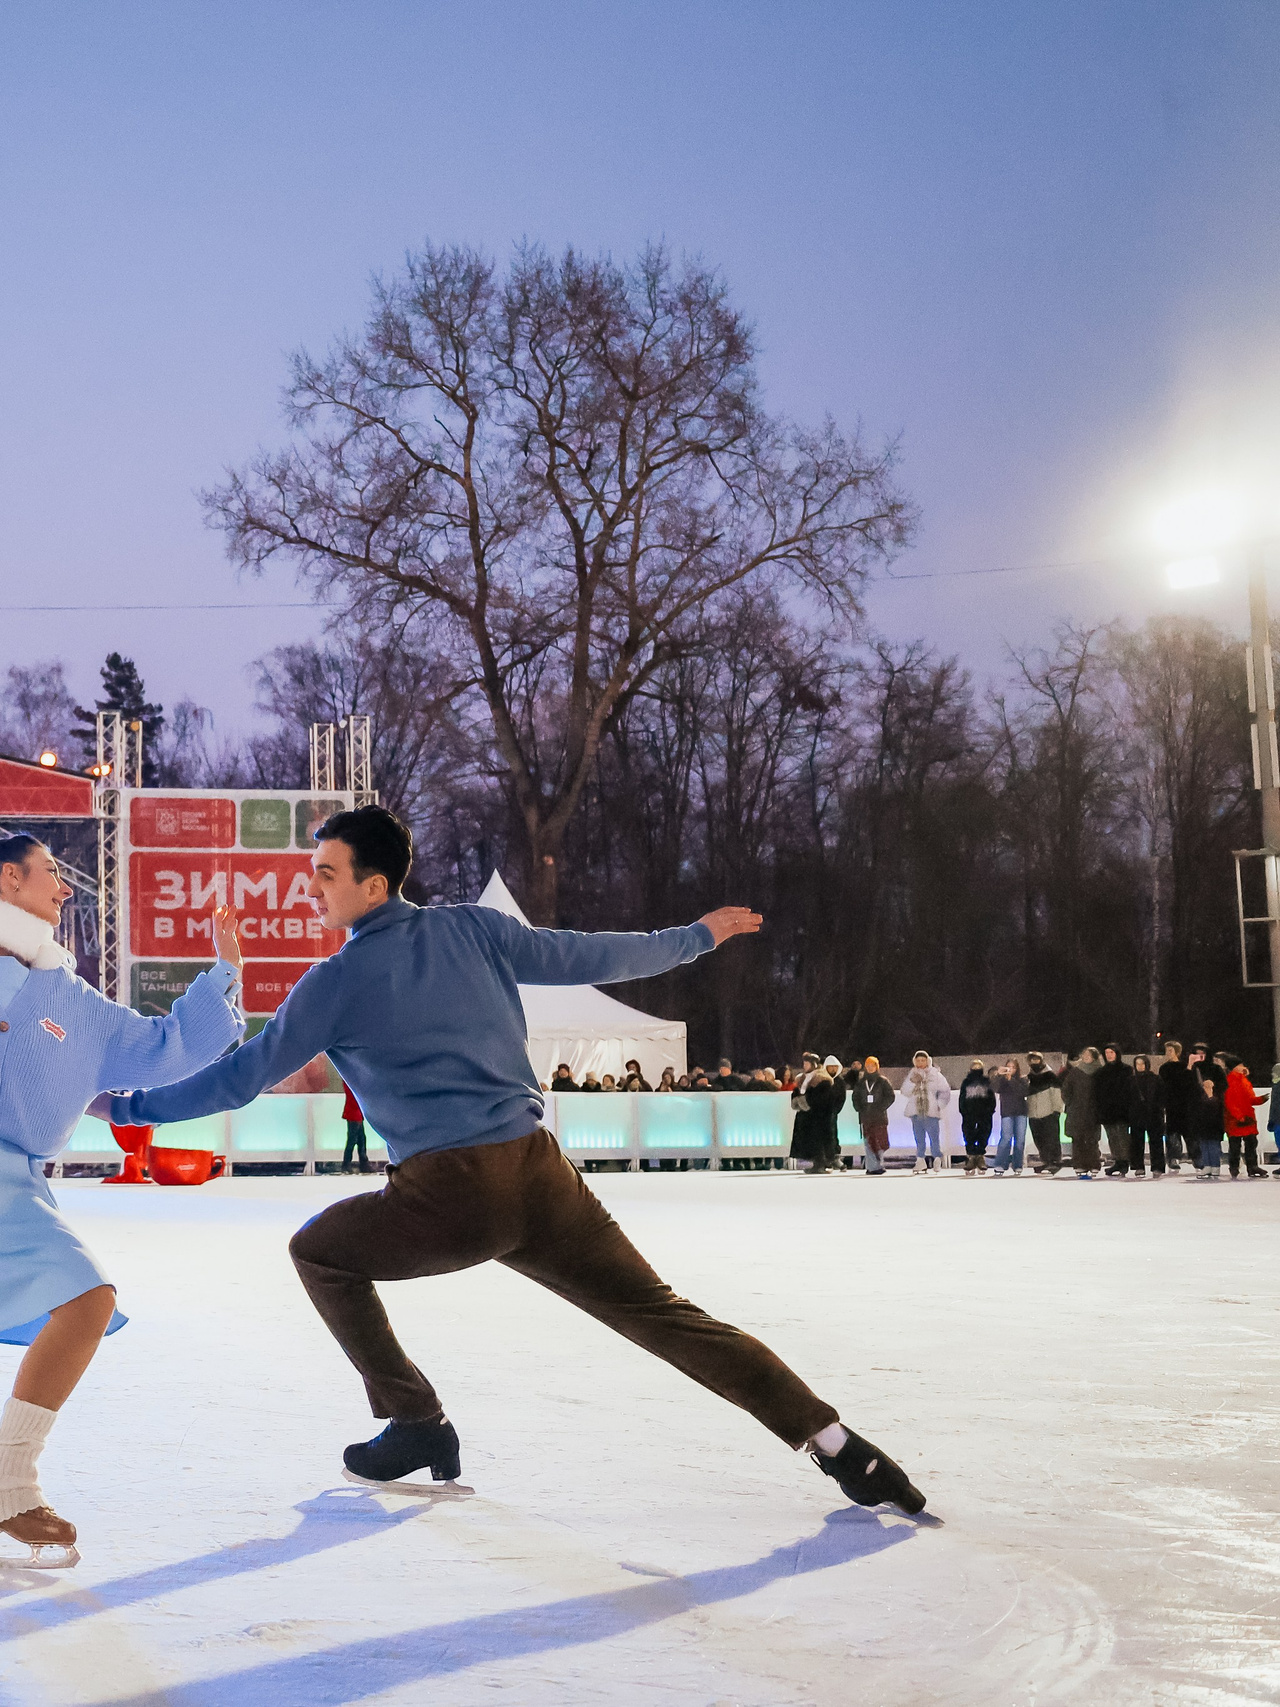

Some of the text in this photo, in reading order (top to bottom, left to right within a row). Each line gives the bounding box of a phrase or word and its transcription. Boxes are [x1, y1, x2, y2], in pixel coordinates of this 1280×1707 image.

[153, 870, 318, 910] ЗИМА
[154, 917, 323, 939] В МСКВЕ
[140, 971, 167, 980] ВСЕ
[255, 983, 282, 992] ВСЕ
